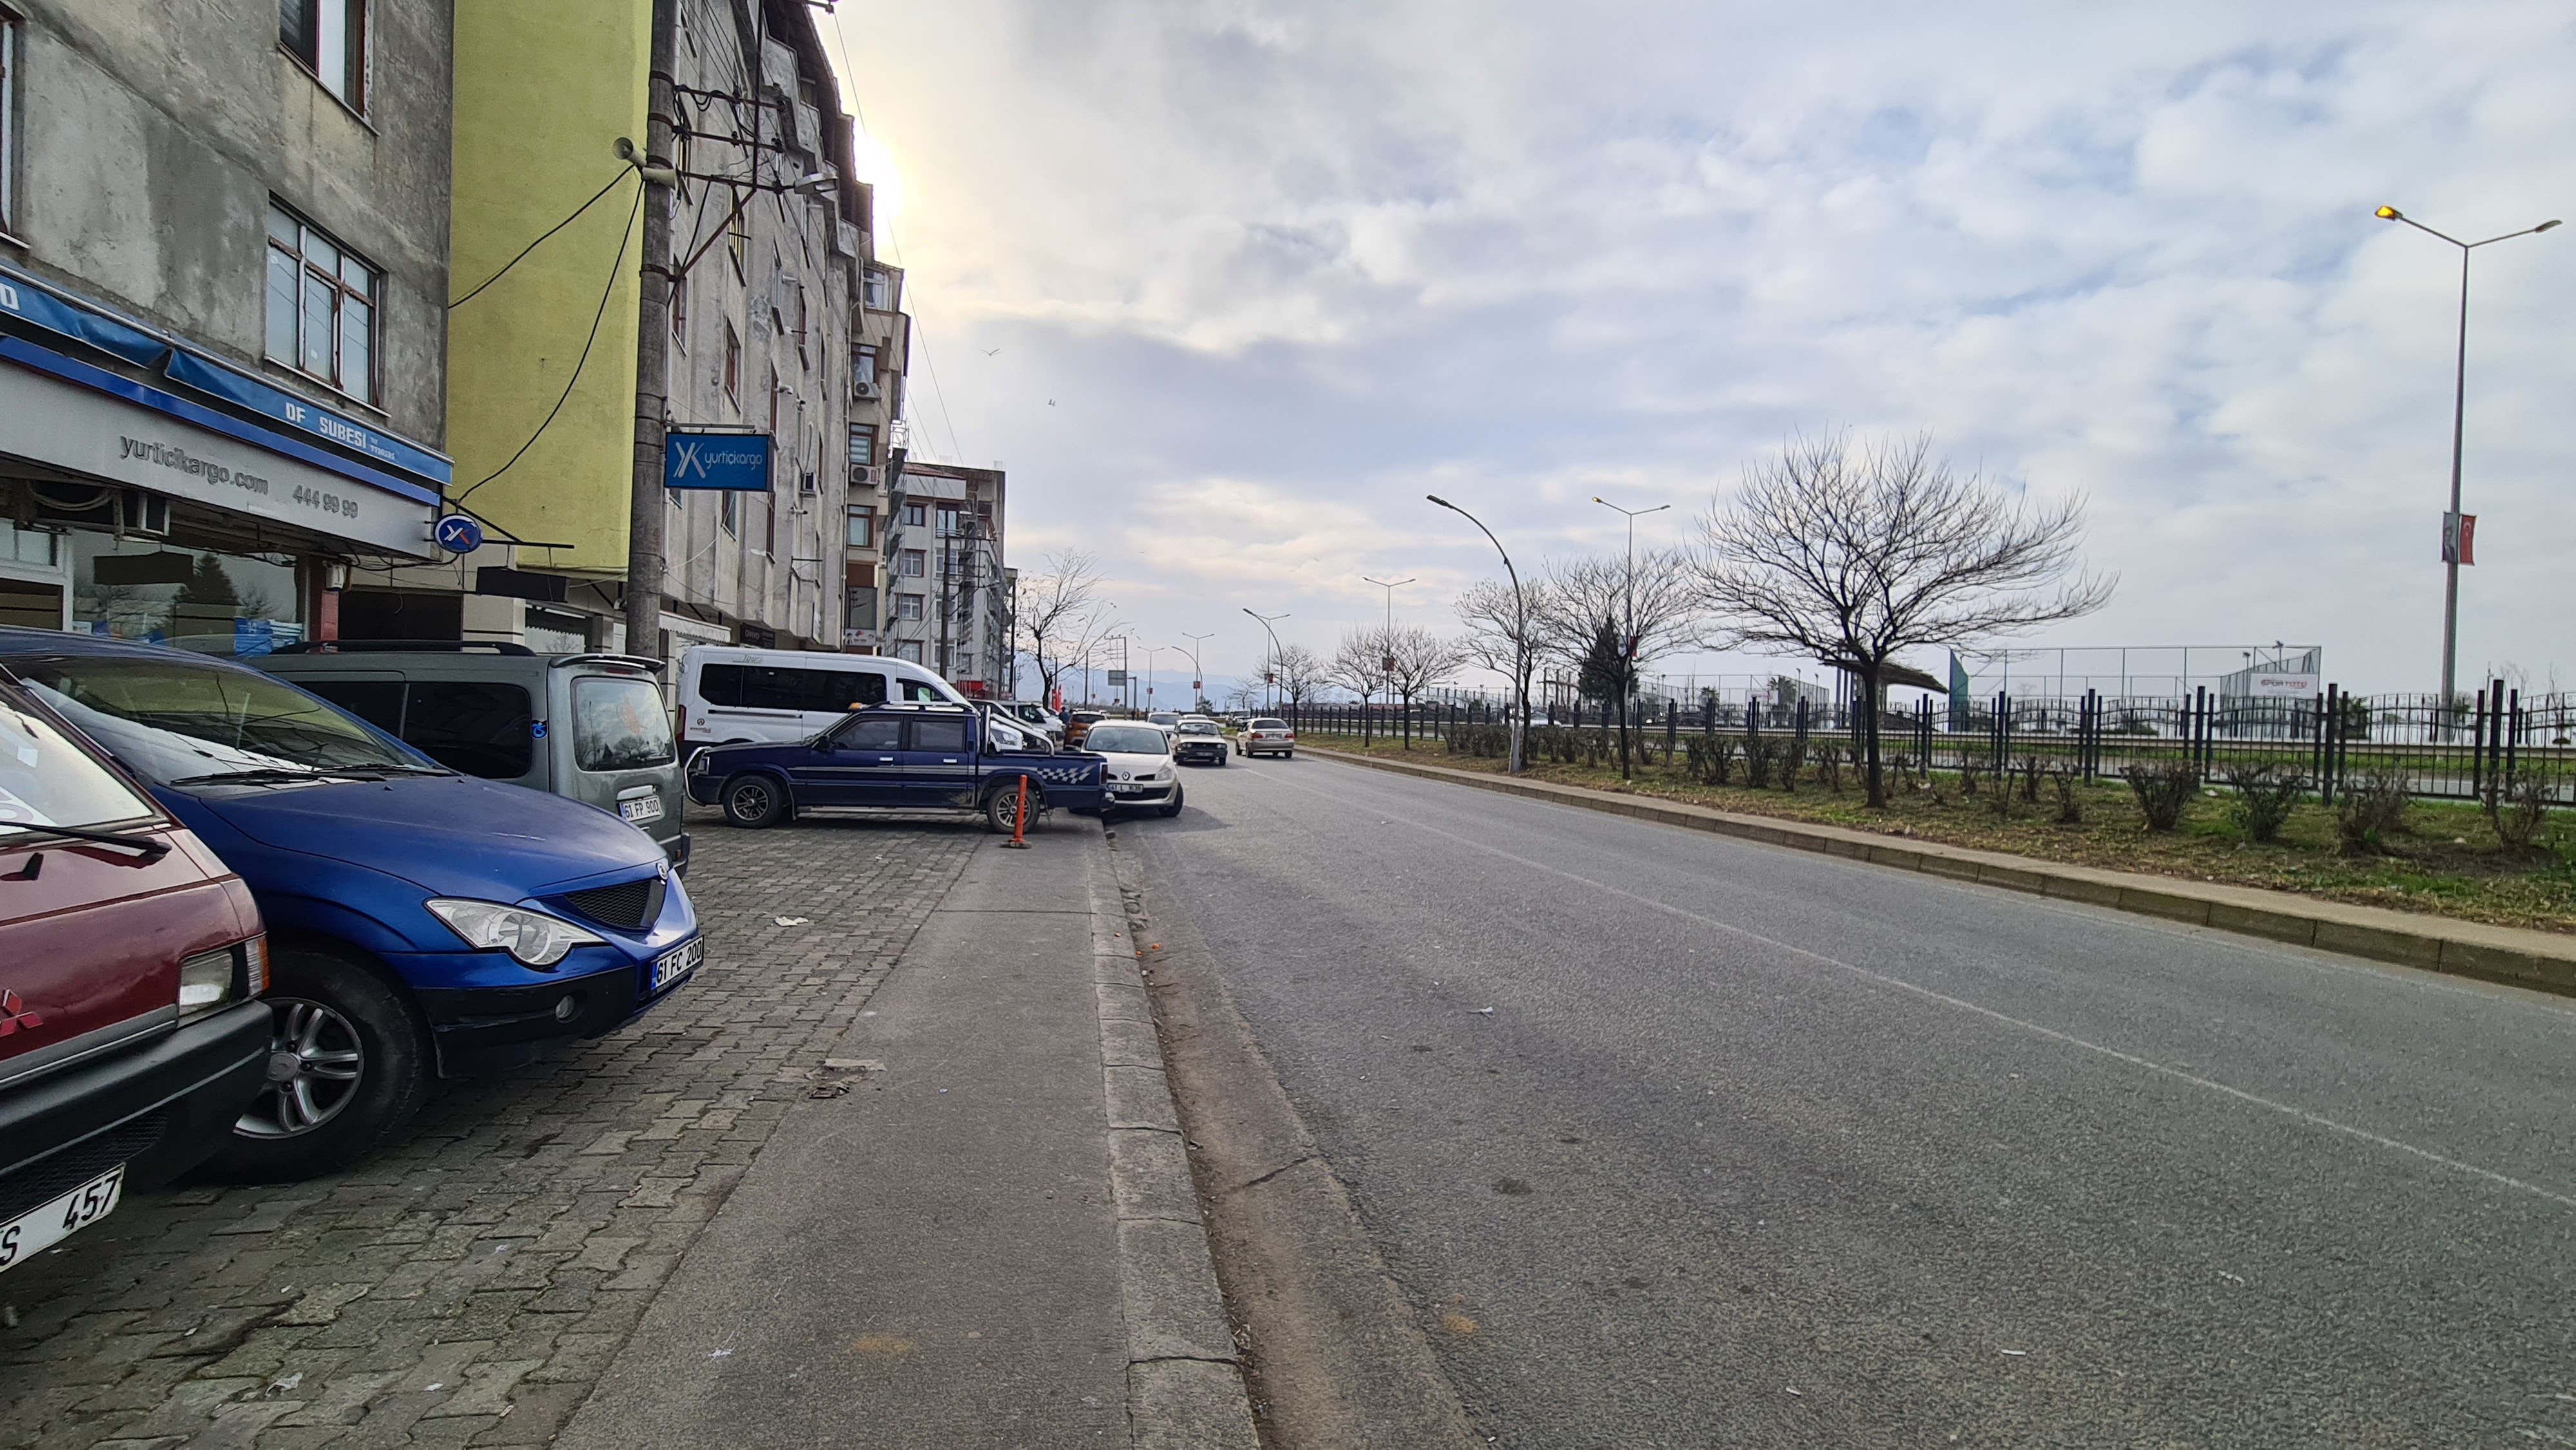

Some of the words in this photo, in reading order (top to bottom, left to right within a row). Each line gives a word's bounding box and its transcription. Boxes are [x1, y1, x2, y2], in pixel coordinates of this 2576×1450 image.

[285, 402, 306, 423] OF
[293, 485, 320, 509] 444
[323, 493, 340, 513] 99
[343, 500, 358, 518] 99
[625, 804, 634, 818] 61
[634, 802, 643, 816] FP
[645, 799, 659, 814] 900
[657, 959, 667, 983] 61
[670, 951, 683, 976] FC
[687, 940, 702, 966] 200
[62, 1172, 121, 1230] 457
